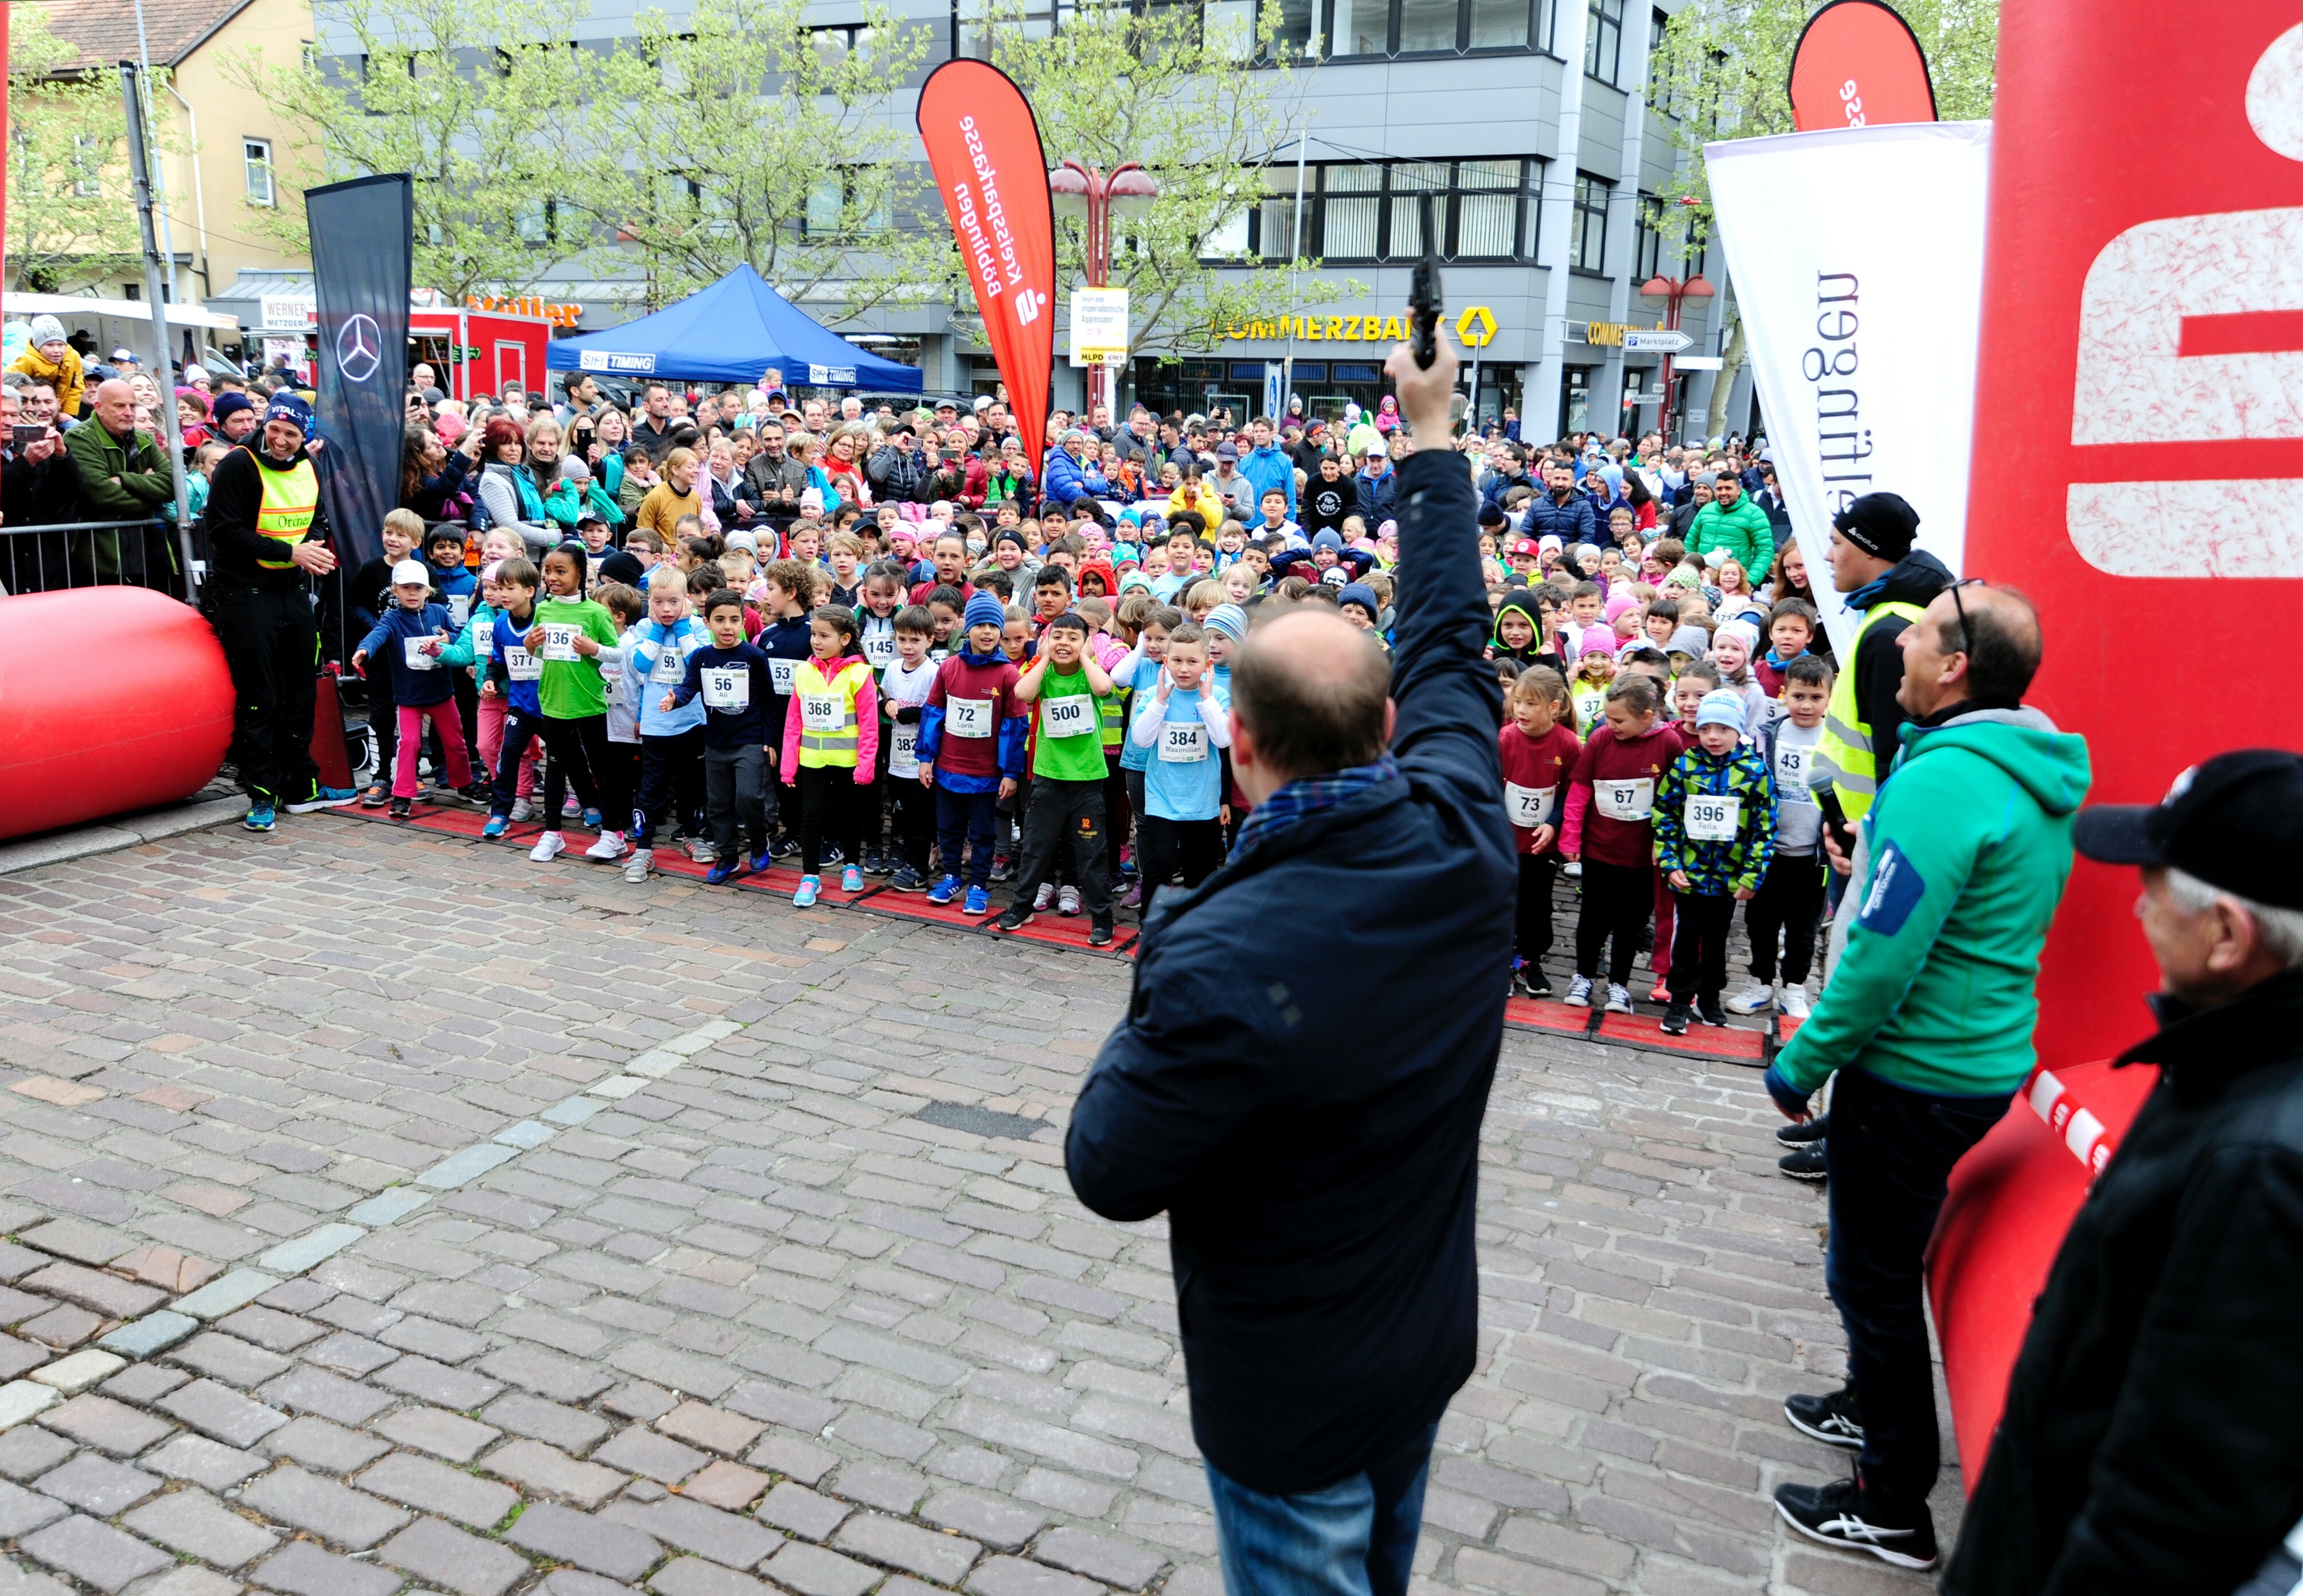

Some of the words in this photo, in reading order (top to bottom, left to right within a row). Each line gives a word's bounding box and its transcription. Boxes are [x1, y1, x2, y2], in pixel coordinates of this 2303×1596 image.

[1082, 305, 1125, 313] imperialistische
[584, 355, 604, 366] SIFI
[610, 356, 653, 370] TIMING
[811, 368, 826, 379] SIFI
[829, 369, 854, 383] TIMING
[272, 405, 297, 417] VITAL
[547, 631, 569, 645] 136
[868, 641, 893, 653] 145
[512, 654, 533, 666] 377
[664, 655, 676, 668] 93
[775, 667, 790, 680] 53
[715, 678, 732, 690] 56
[808, 702, 832, 716] 368
[958, 707, 974, 721] 72
[1051, 705, 1080, 721] 500
[897, 738, 917, 751] 382
[1169, 731, 1197, 745] 384
[1781, 754, 1800, 769] 43
[1615, 789, 1634, 803] 67
[1521, 796, 1540, 811] 73
[1693, 806, 1724, 821] 396
[1082, 818, 1090, 828] 92
[1872, 862, 1897, 909] ORTOVOX
